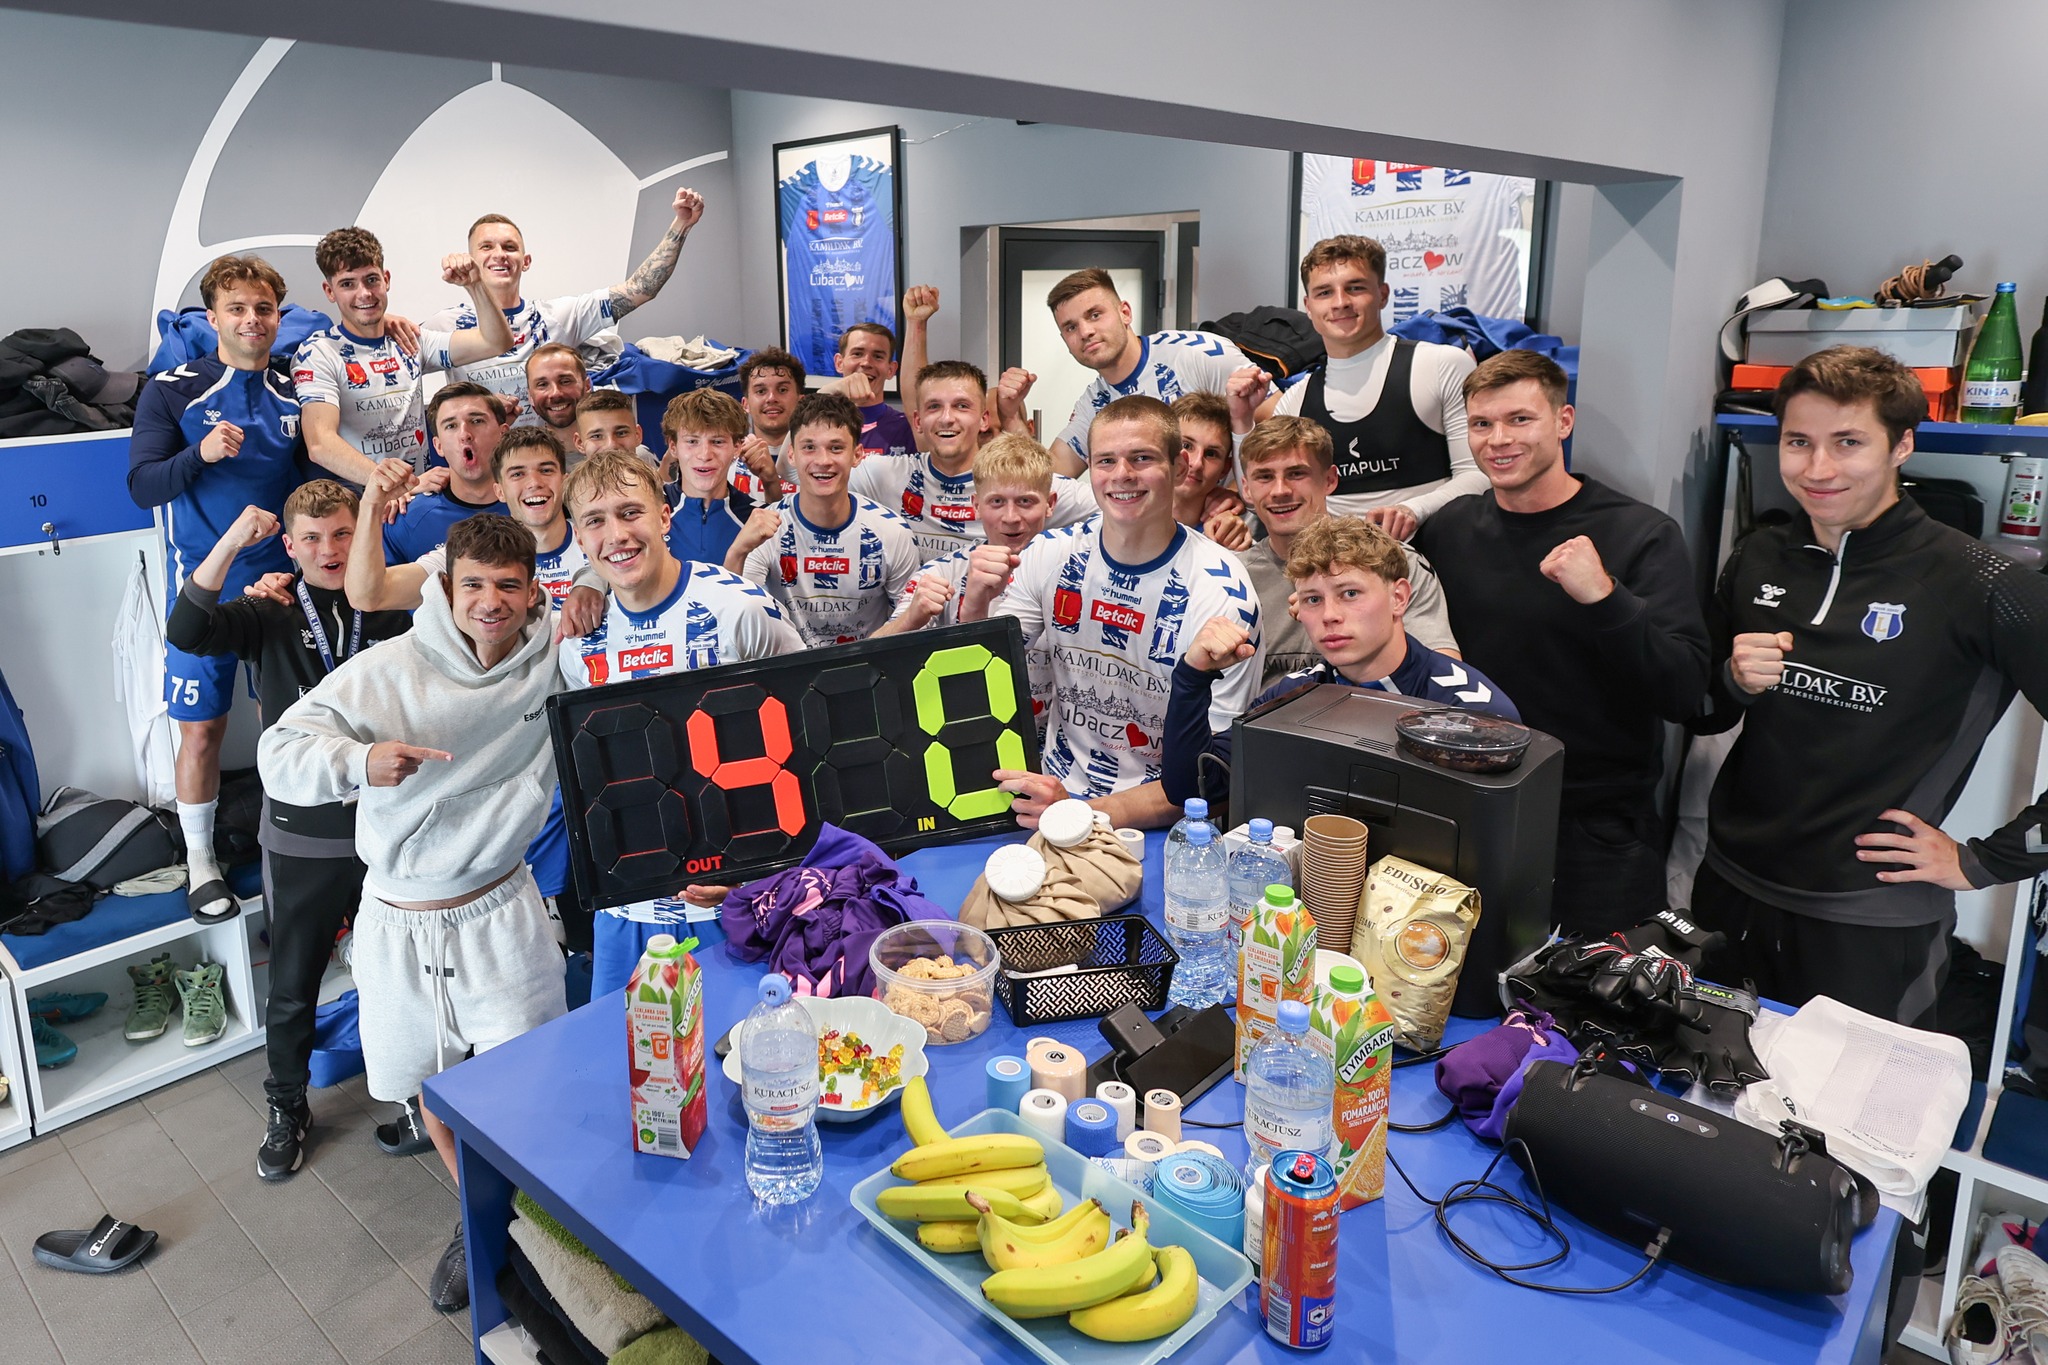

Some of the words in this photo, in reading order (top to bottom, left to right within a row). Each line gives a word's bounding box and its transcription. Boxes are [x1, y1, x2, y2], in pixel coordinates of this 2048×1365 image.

[824, 212, 846, 221] Betclic
[1355, 203, 1437, 223] KAMILDAK
[1443, 200, 1465, 216] B.V.
[808, 241, 851, 251] KAMILDAK
[466, 365, 526, 382] KAMILDA
[1966, 387, 2009, 396] KINGA
[356, 393, 412, 411] KAMILDA
[1336, 457, 1400, 477] ATAPULT
[29, 494, 47, 508] 10
[934, 507, 971, 519] Betclic
[818, 546, 844, 554] hummel
[542, 569, 570, 579] hummel
[808, 560, 846, 571] Betclic
[1109, 589, 1142, 606] hummel
[1095, 604, 1139, 629] Betclic
[634, 630, 667, 643] hummel
[622, 649, 669, 669] Betclic
[1053, 645, 1140, 687] KAMILDAK
[1146, 677, 1171, 694] B.V.
[171, 675, 200, 706] 75
[1850, 685, 1888, 706] B.V.
[1783, 688, 1873, 713] DAKBEDEKKINGEN
[686, 695, 806, 837] 4
[912, 644, 1028, 821] 0
[917, 816, 935, 831] IN
[686, 855, 723, 874] OUT
[1290, 930, 1318, 978] TYMBARK
[1342, 1028, 1393, 1077] TYMBARK
[754, 1081, 812, 1098] KURACJUSZ
[1367, 1087, 1386, 1103] 100%
[1341, 1098, 1388, 1123] POMARAŃCZA
